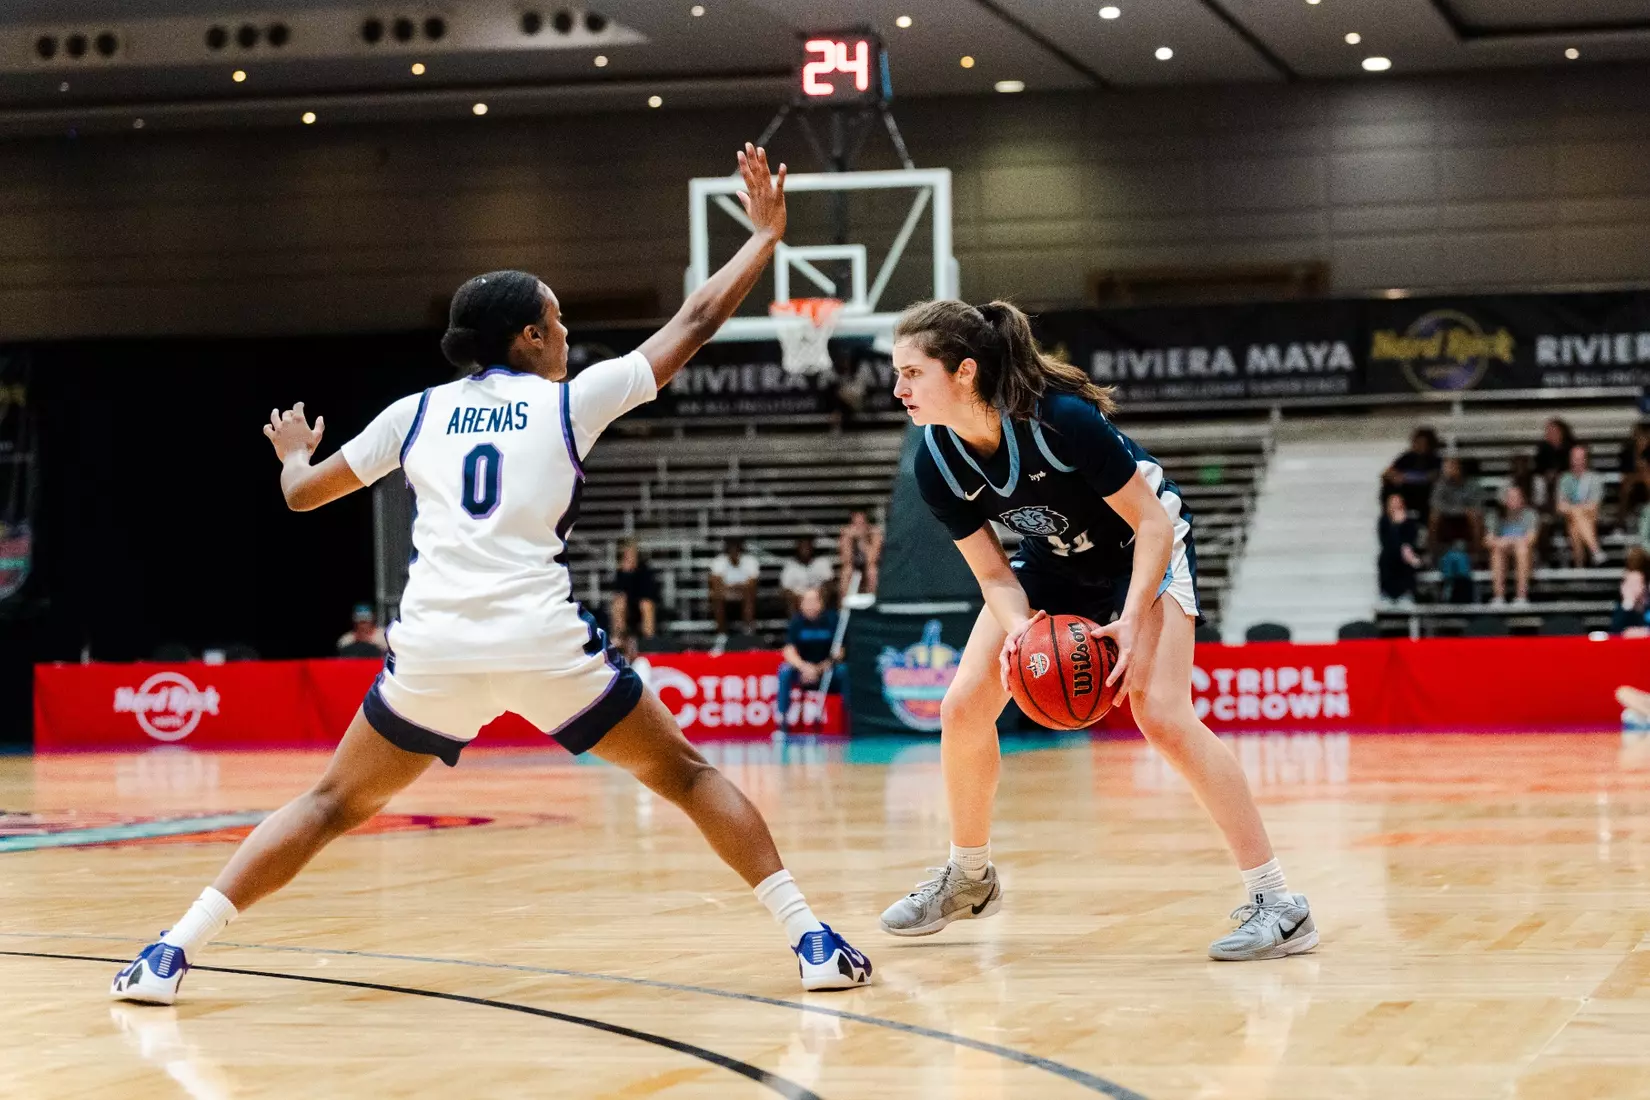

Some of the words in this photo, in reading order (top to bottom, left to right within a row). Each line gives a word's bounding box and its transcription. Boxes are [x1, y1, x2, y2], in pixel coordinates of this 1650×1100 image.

[803, 39, 868, 95] 24
[1092, 347, 1237, 380] RIVIERA
[1246, 341, 1354, 374] MAYA
[446, 401, 529, 435] ARENAS
[460, 442, 504, 520] 0
[1067, 622, 1093, 697] Wilson
[1211, 665, 1348, 693] TRIPLE
[1211, 692, 1349, 721] CROWN
